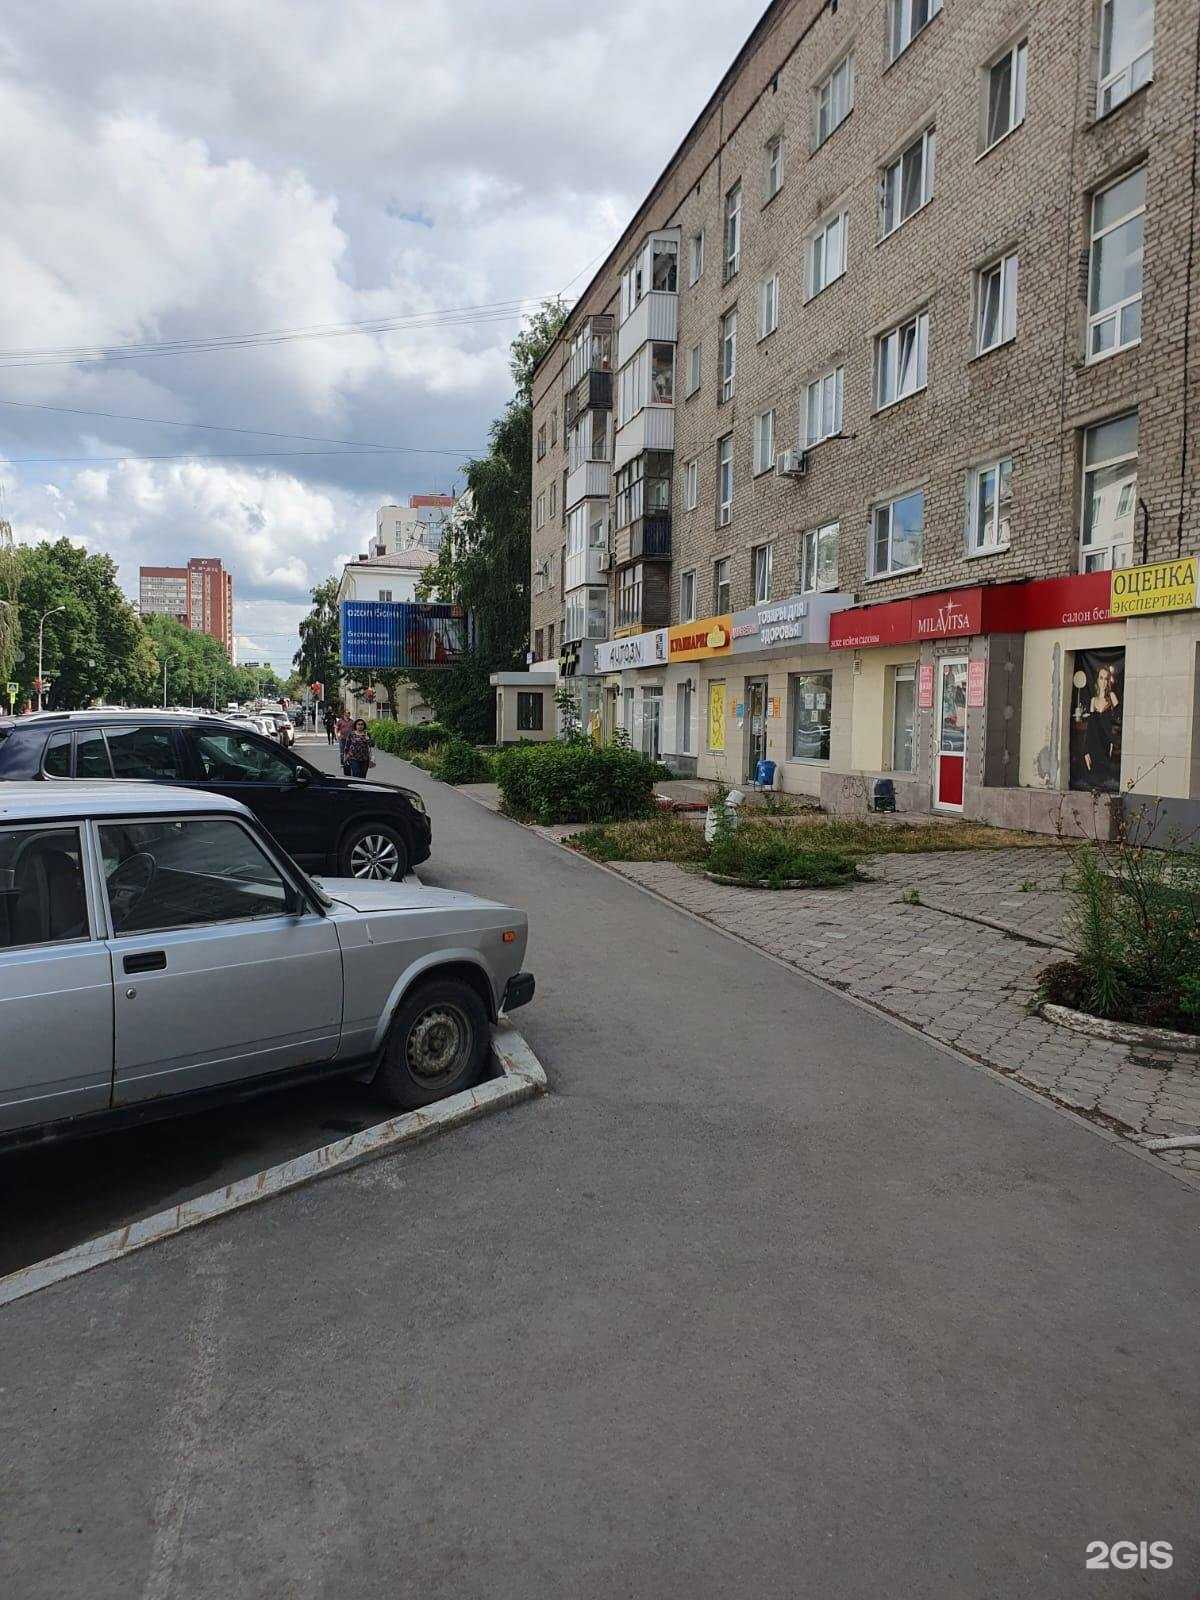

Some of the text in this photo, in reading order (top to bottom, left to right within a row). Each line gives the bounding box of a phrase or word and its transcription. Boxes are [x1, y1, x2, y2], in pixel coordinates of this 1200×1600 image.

[1113, 563, 1195, 596] ОЦЕНКА
[758, 601, 808, 625] ТОВАРЫ ДЛЯ
[1062, 607, 1110, 623] салон бел
[1113, 592, 1193, 614] ЭКСПЕРТИЗА
[918, 608, 970, 634] MILAVITSA
